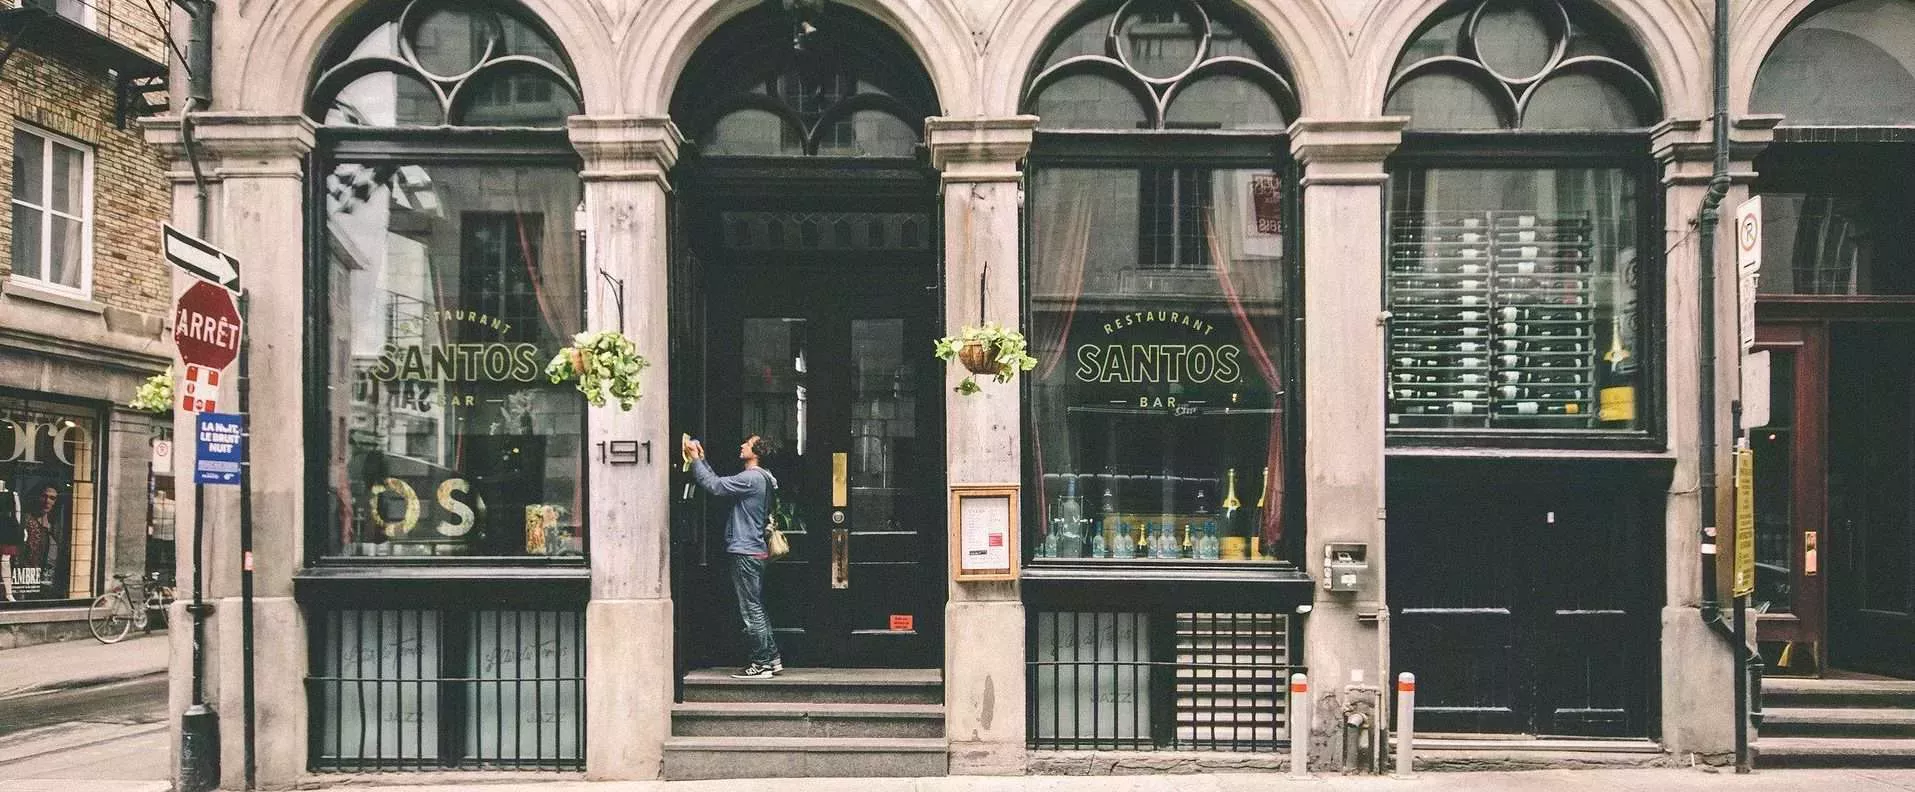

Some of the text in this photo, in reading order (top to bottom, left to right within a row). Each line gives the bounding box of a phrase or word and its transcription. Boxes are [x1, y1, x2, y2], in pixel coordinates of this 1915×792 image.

[177, 307, 240, 350] ARRÊT
[401, 309, 513, 334] STAURANT
[1103, 311, 1216, 336] RESTAURANT
[372, 342, 538, 382] SANTOS
[1075, 343, 1241, 384] SANTOS
[435, 394, 475, 408] BAR
[1139, 396, 1176, 408] BAR
[200, 431, 212, 442] LE
[201, 421, 214, 432] LA
[208, 442, 233, 453] NUIT
[596, 440, 651, 464] 191
